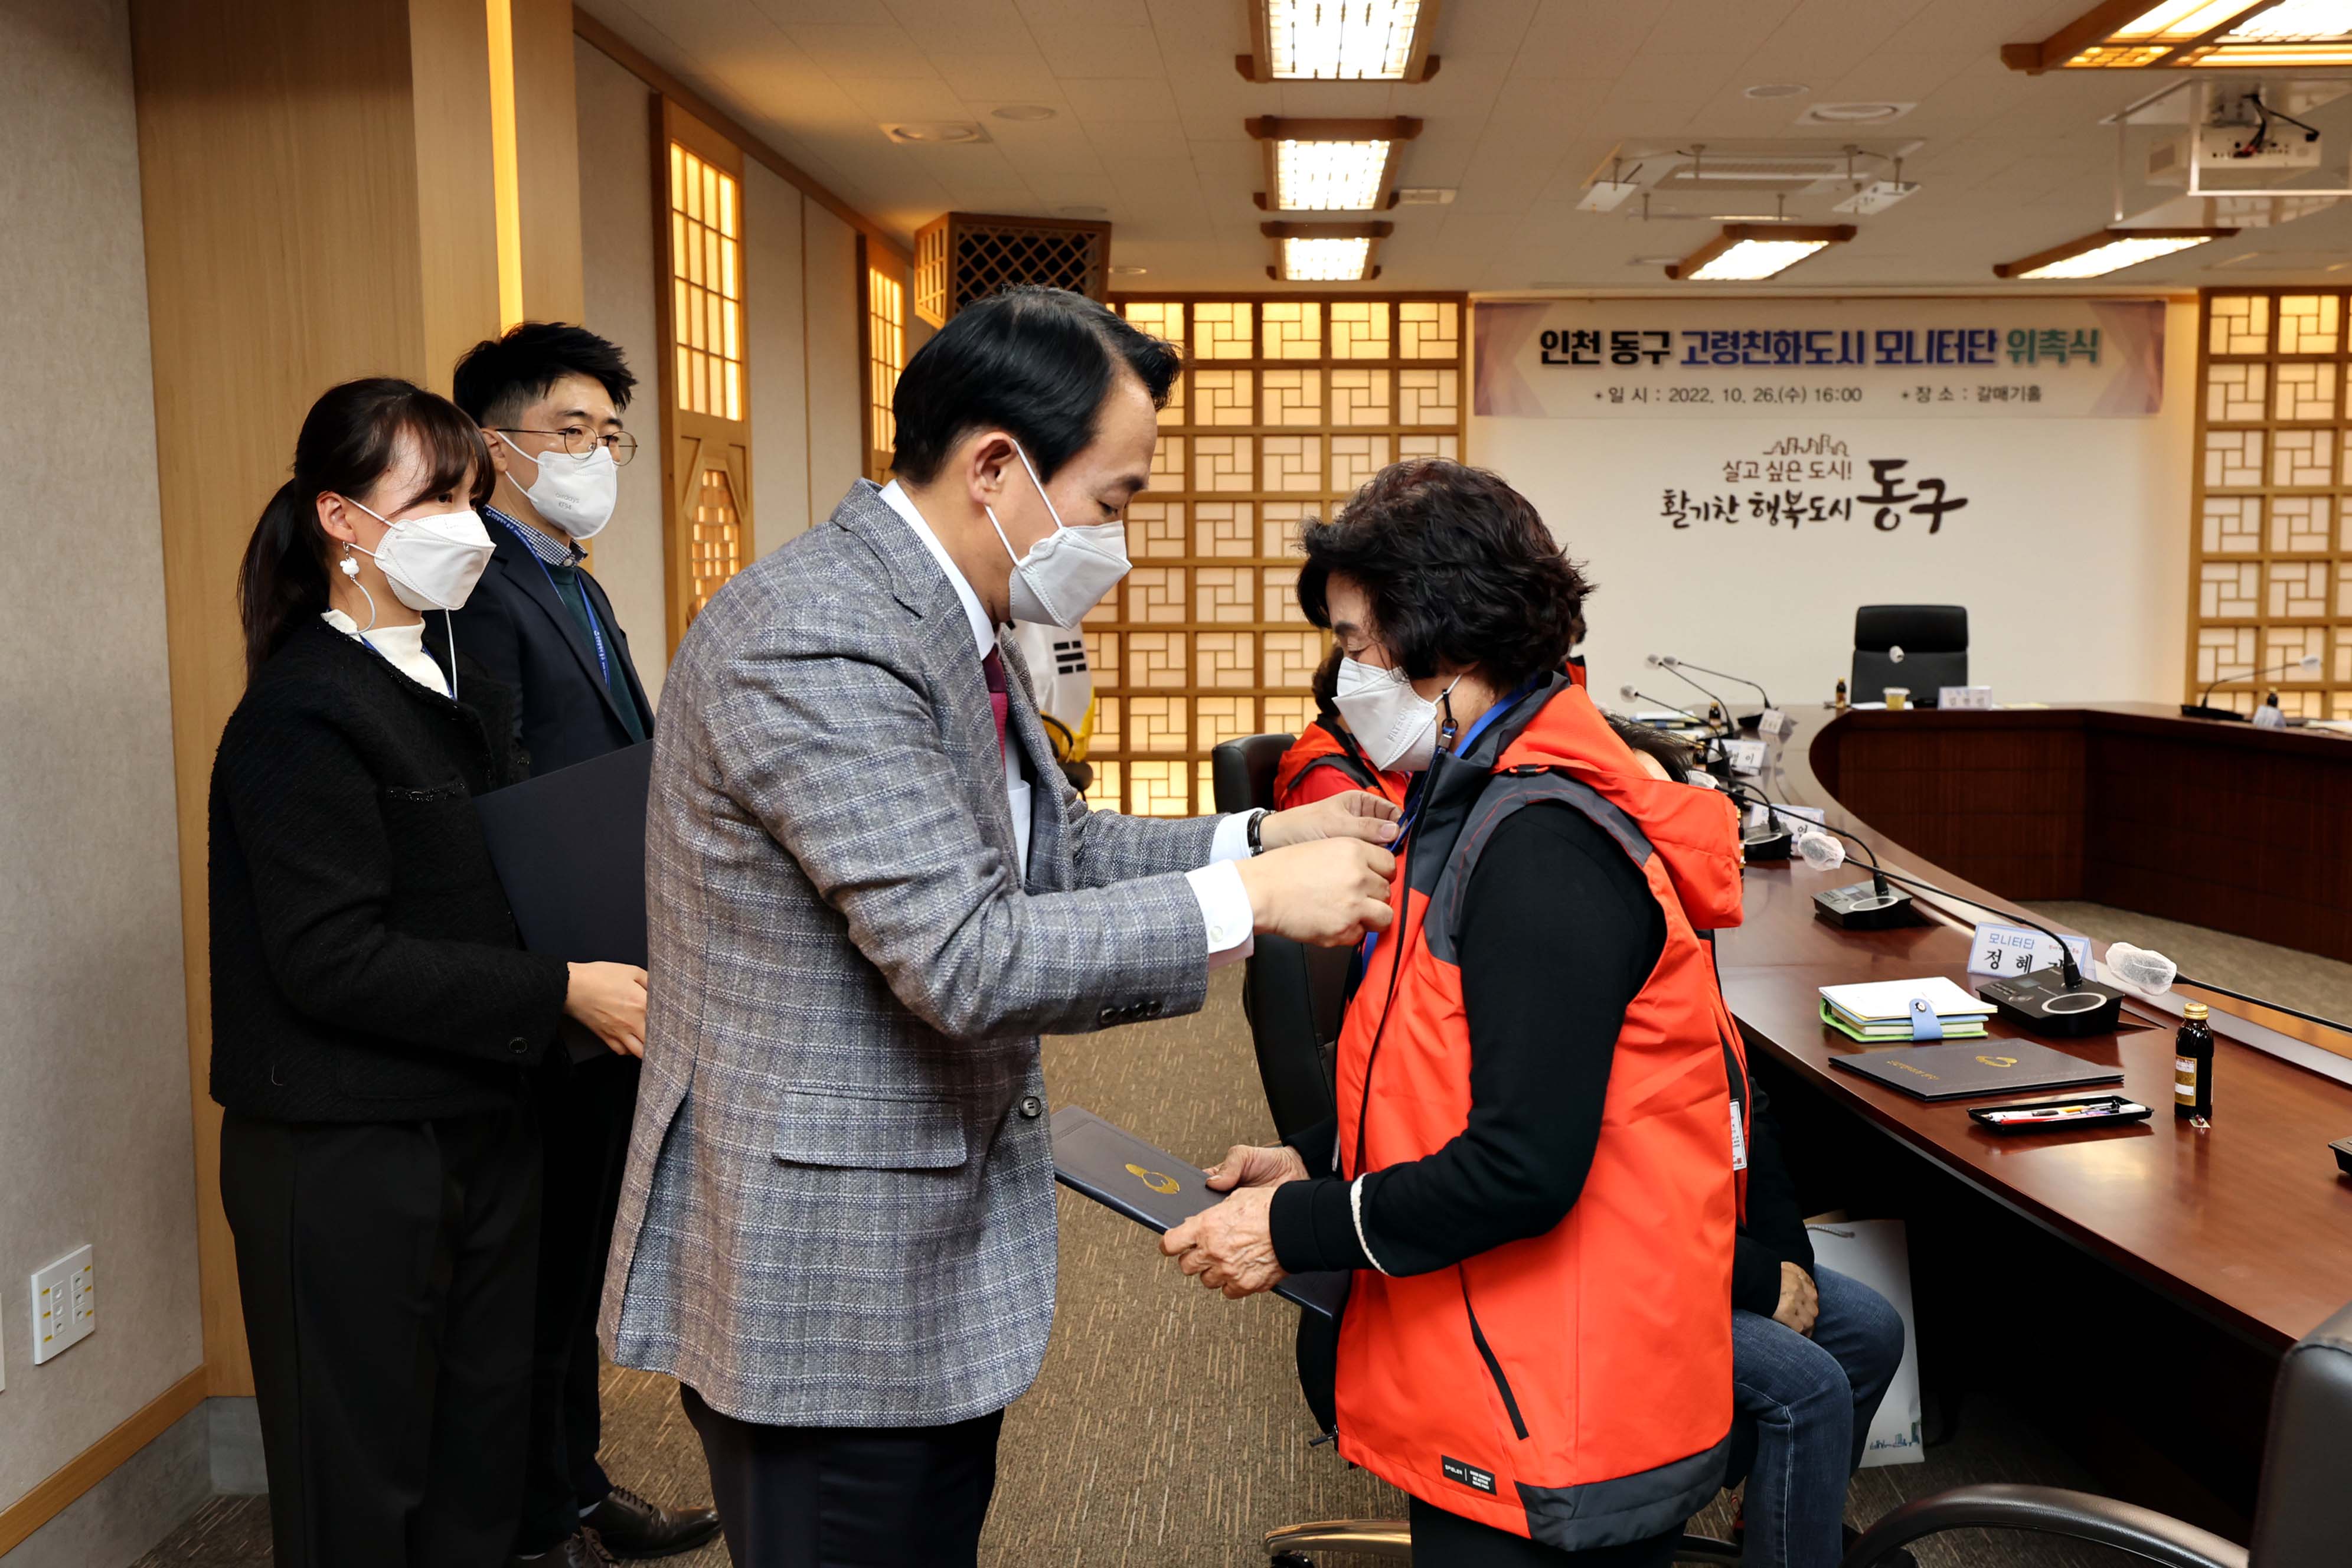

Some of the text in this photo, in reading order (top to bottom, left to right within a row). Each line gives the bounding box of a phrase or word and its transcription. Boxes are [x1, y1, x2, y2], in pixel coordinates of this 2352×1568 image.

[1540, 329, 2099, 365] 인천 동구 고령친화도시 모니터단 위촉식
[1815, 387, 1862, 402] 16:00
[1723, 460, 1852, 482] 살고 싶은 도시!
[1661, 459, 1968, 534] 활기찬 행복도시 동구
[1989, 933, 2035, 949] 모니터단
